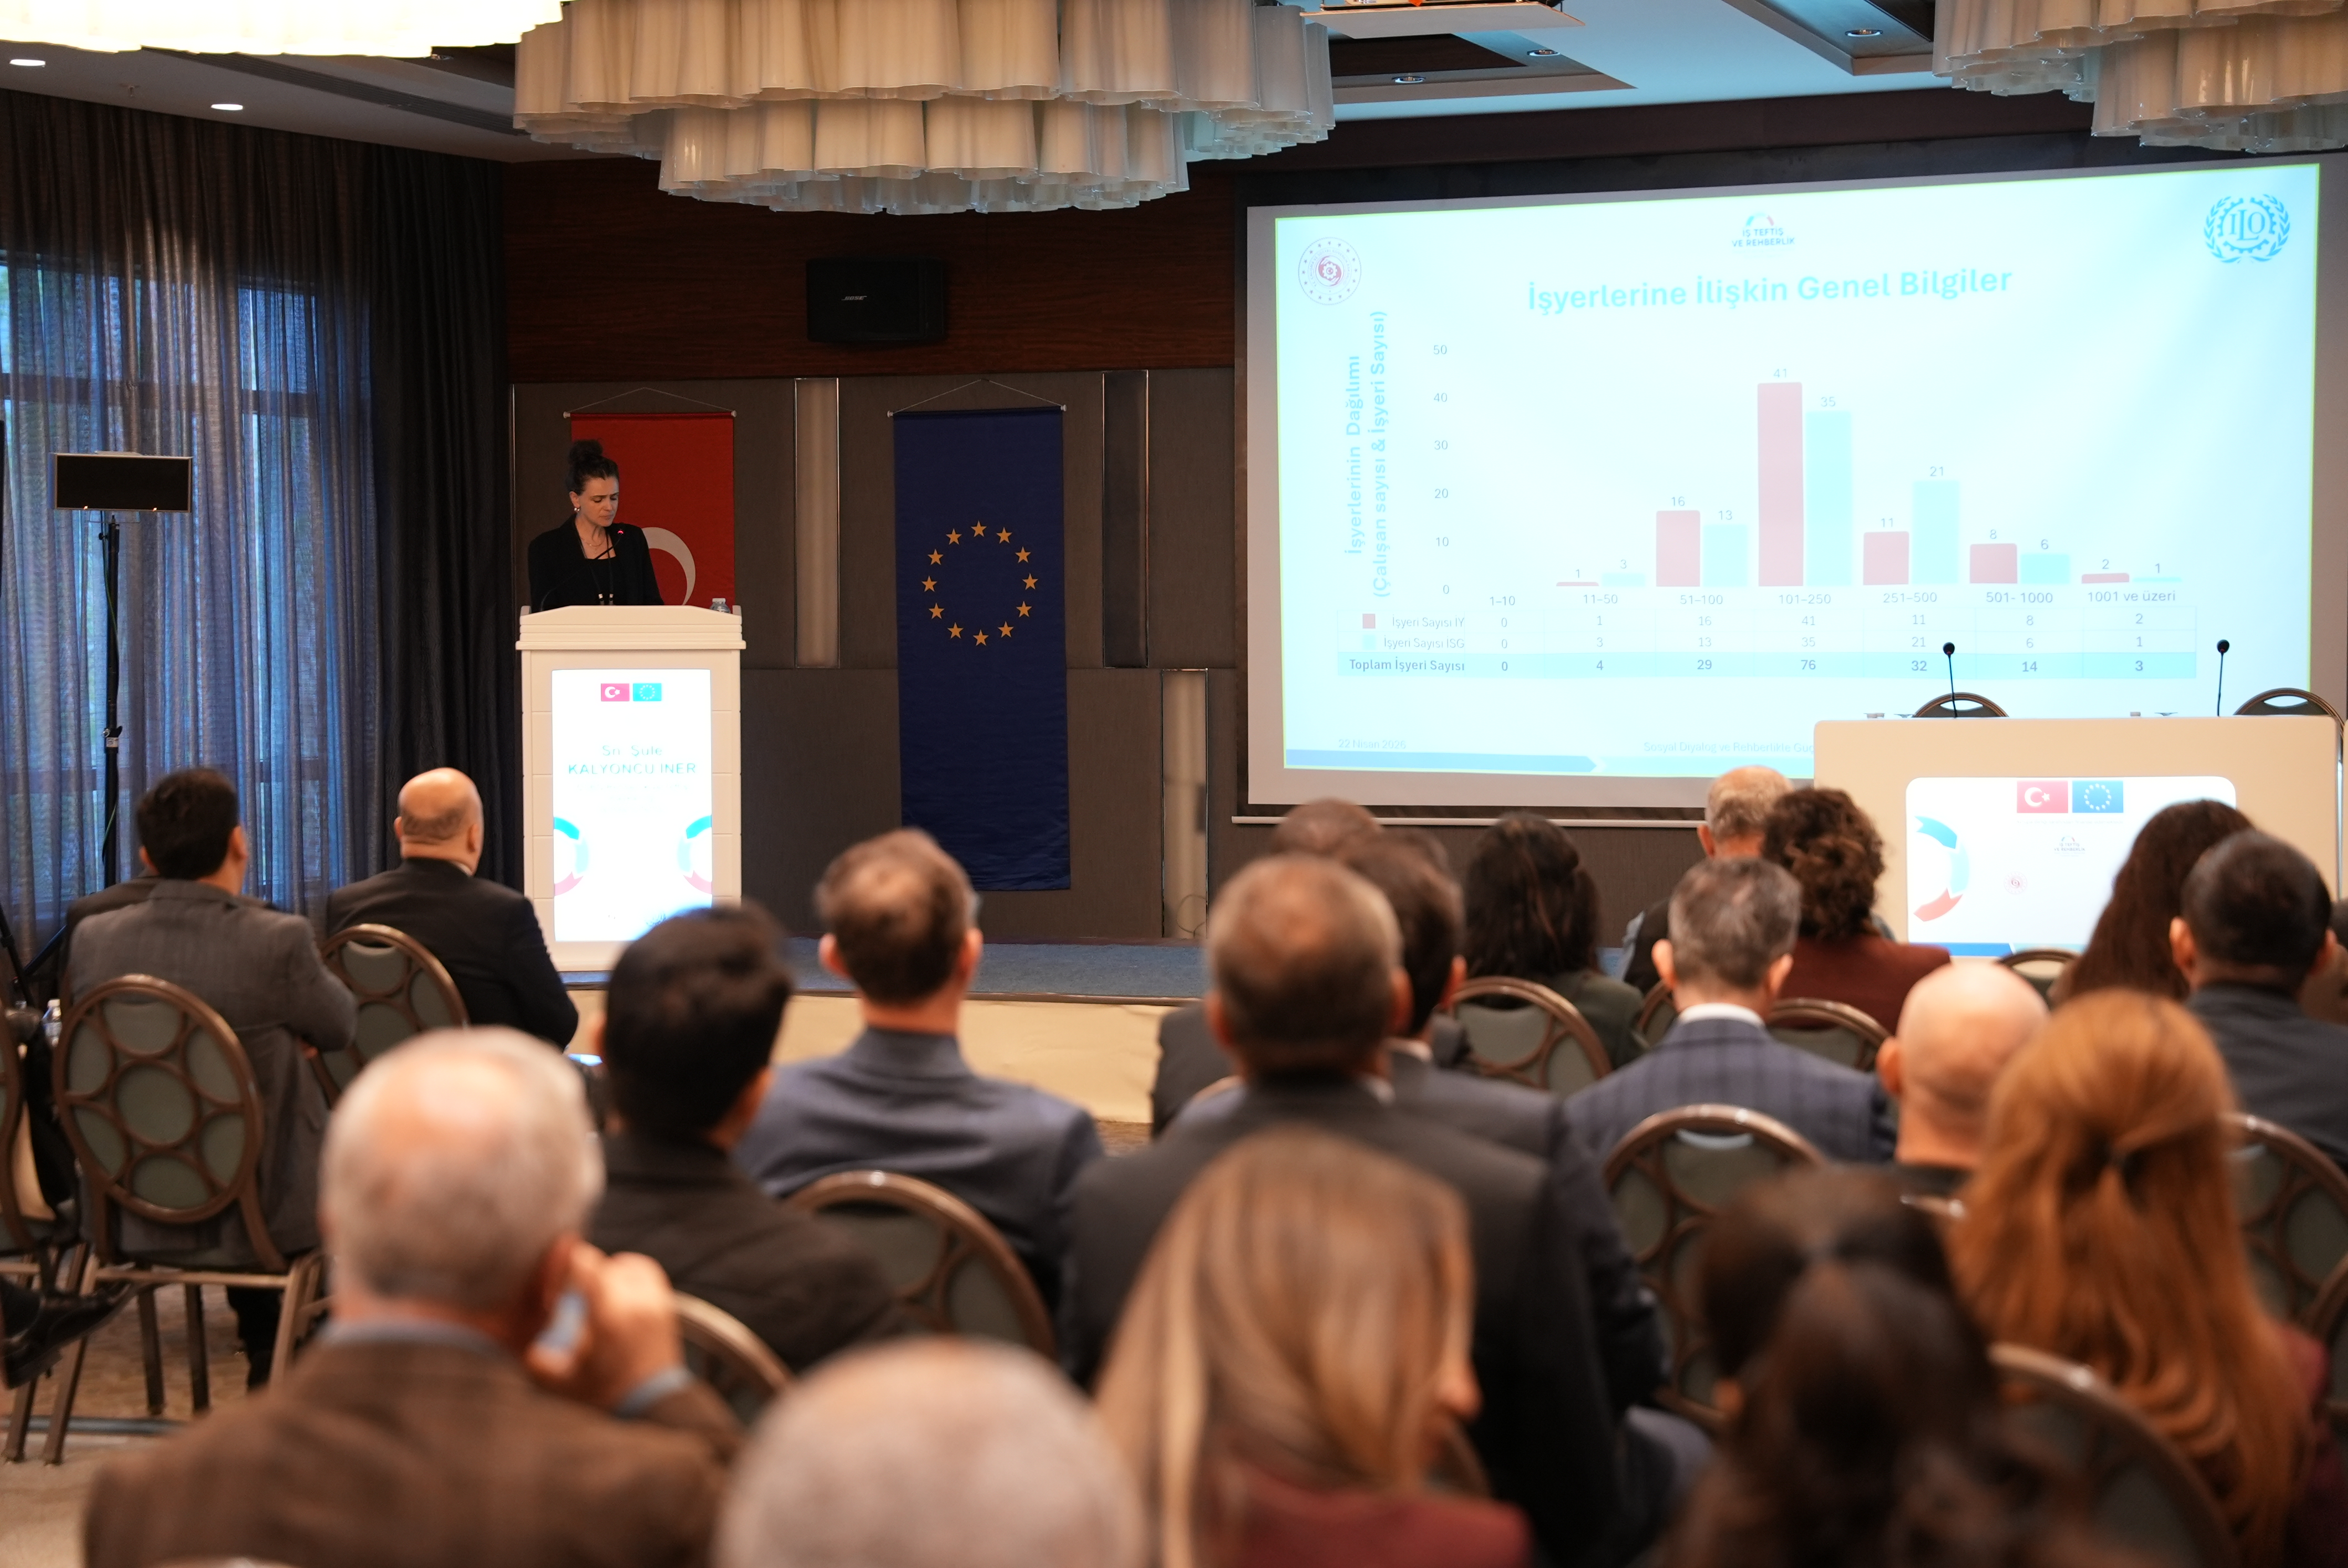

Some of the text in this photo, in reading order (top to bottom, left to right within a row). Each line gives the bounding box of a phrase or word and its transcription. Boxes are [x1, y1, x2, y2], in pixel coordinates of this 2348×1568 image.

[2228, 209, 2266, 241] ILO
[1743, 226, 1784, 237] İŞ TEFTİŞ
[1746, 236, 1795, 246] REHBERLİK
[1530, 269, 2012, 316] İşyerlerine İlişkin Genel Bilgiler
[1434, 345, 1447, 355] 50
[1773, 368, 1786, 378] 41
[1434, 393, 1447, 402] 40
[1821, 396, 1836, 407] 35
[1435, 440, 1448, 450] 30
[1345, 356, 1365, 554] İşyerlerinin Dağılımı
[1368, 312, 1391, 597] (Çalışan sayısı & İşyeri Sayısı)
[1930, 466, 1943, 477] 21
[1435, 488, 1448, 498] 20
[1672, 496, 1685, 506] 16
[1718, 510, 1732, 520] 13
[1881, 518, 1893, 527] 11
[1990, 529, 1997, 539] 8
[1436, 537, 1449, 546] 10
[2041, 539, 2048, 550] 6
[1620, 559, 1627, 569] 3
[2102, 559, 2109, 569] 2
[2155, 563, 2160, 573] 1
[1575, 569, 1580, 579] 1
[1443, 585, 1449, 594] 0
[1986, 592, 2053, 603] 501- 1000
[2088, 591, 2118, 602] 1001
[2143, 591, 2176, 602] üzeri
[1392, 614, 1464, 629] İşyeri Sayısı İY
[1501, 617, 1507, 627] 0
[1597, 616, 1602, 626] 1
[1699, 616, 1712, 626] 16
[1802, 616, 1815, 626] 41
[1913, 615, 1925, 625] 11
[2026, 615, 2033, 626] 8
[2136, 613, 2143, 624] 2
[1384, 635, 1464, 650] İşyeri Sayısı İSG
[1501, 639, 1507, 648] 0
[1597, 637, 1603, 647] 3
[1699, 637, 1712, 647] 13
[1802, 637, 1815, 647] 35
[1912, 637, 1925, 647] 21
[2026, 638, 2033, 648] 6
[2136, 637, 2143, 647] 1
[1350, 657, 1464, 672] Toplam İşyeri Sayısı
[1502, 662, 1508, 671] 0
[1597, 660, 1603, 670] 4
[1697, 659, 1712, 670] 29
[1801, 660, 1816, 670] 76
[1912, 661, 1927, 671] 32
[2022, 661, 2037, 672] 14
[2135, 661, 2143, 671] 3
[1339, 739, 1406, 749] 22 Nisan 2026
[1644, 742, 1676, 754] Sosyal
[1680, 742, 1717, 754] Diyalog
[1733, 742, 1791, 752] Rehberlikle
[631, 746, 662, 757] Şule
[569, 764, 653, 774] KALYONCU
